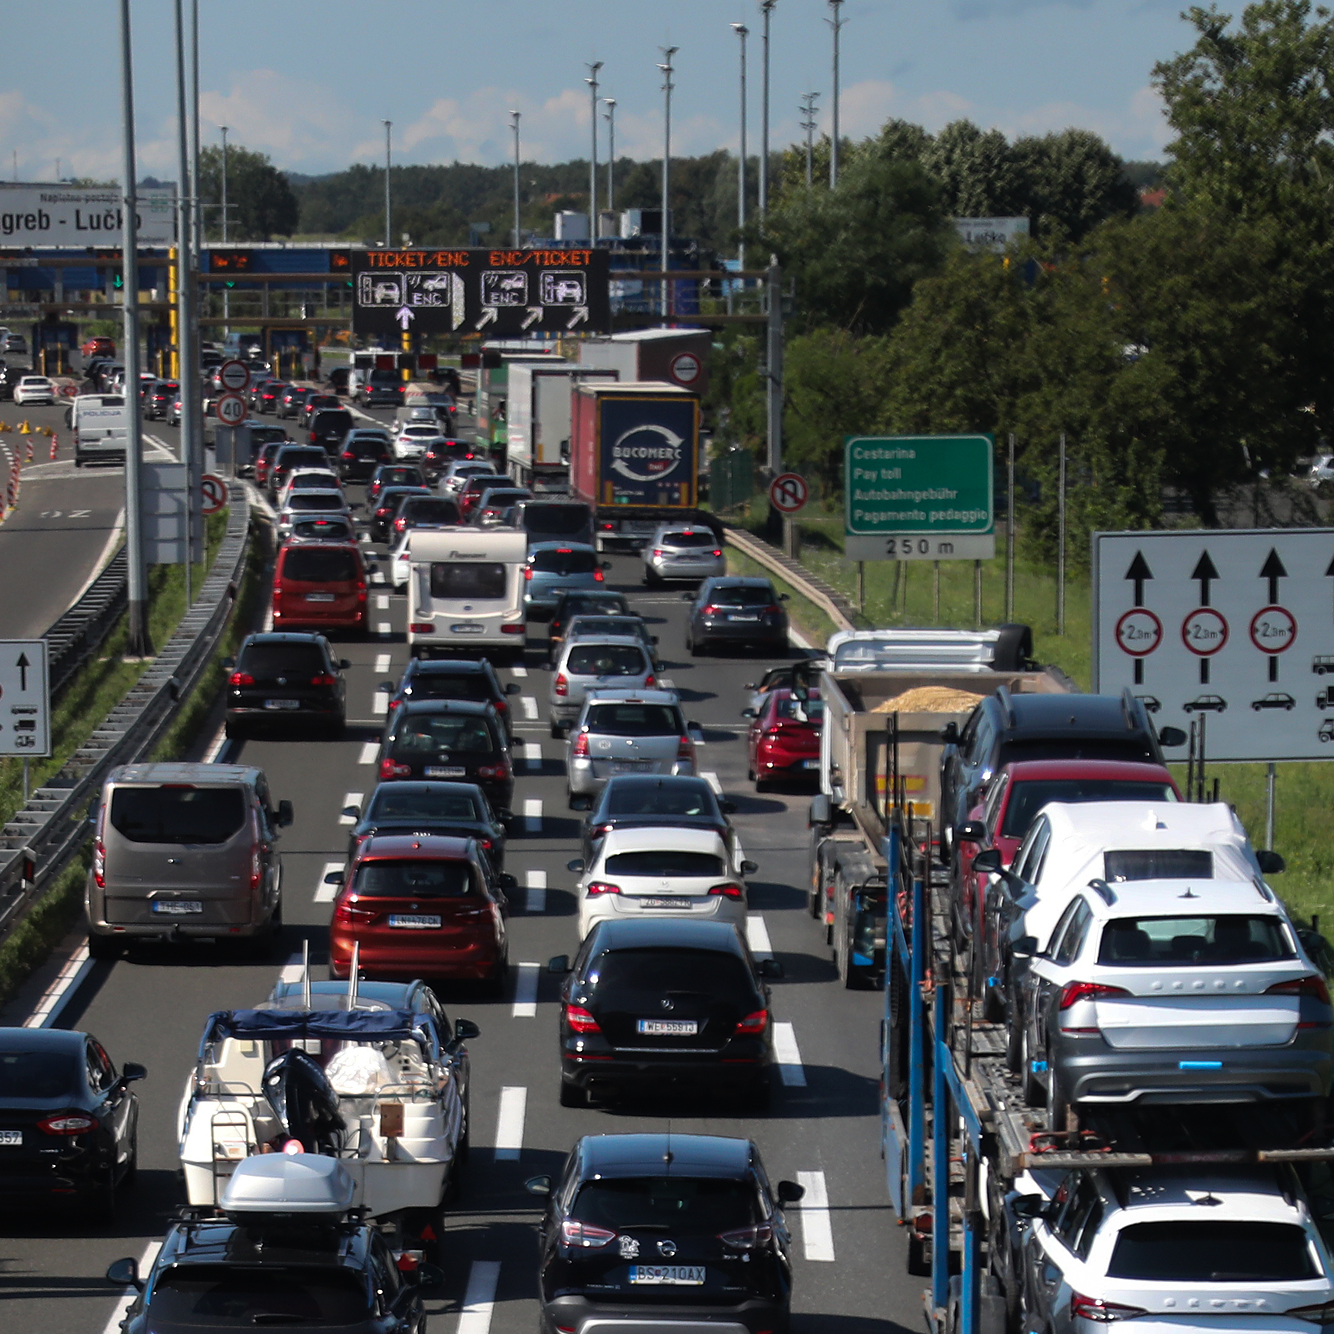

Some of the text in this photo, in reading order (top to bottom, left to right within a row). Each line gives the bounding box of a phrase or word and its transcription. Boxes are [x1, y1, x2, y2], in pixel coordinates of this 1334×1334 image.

[368, 251, 470, 267] TICKET/ENC
[489, 250, 593, 266] ENC/TICKET
[413, 292, 441, 305] ENC
[490, 291, 518, 304] ENC
[224, 402, 241, 417] 40
[612, 446, 683, 460] BUCOMERC
[853, 447, 917, 460] Cestarina
[853, 467, 902, 482] Pay toll
[853, 487, 959, 503] Autobahngebühr
[854, 508, 988, 525] Pagamento pedaggio
[886, 539, 955, 554] 250 m
[638, 1266, 704, 1280] BS 210AX
